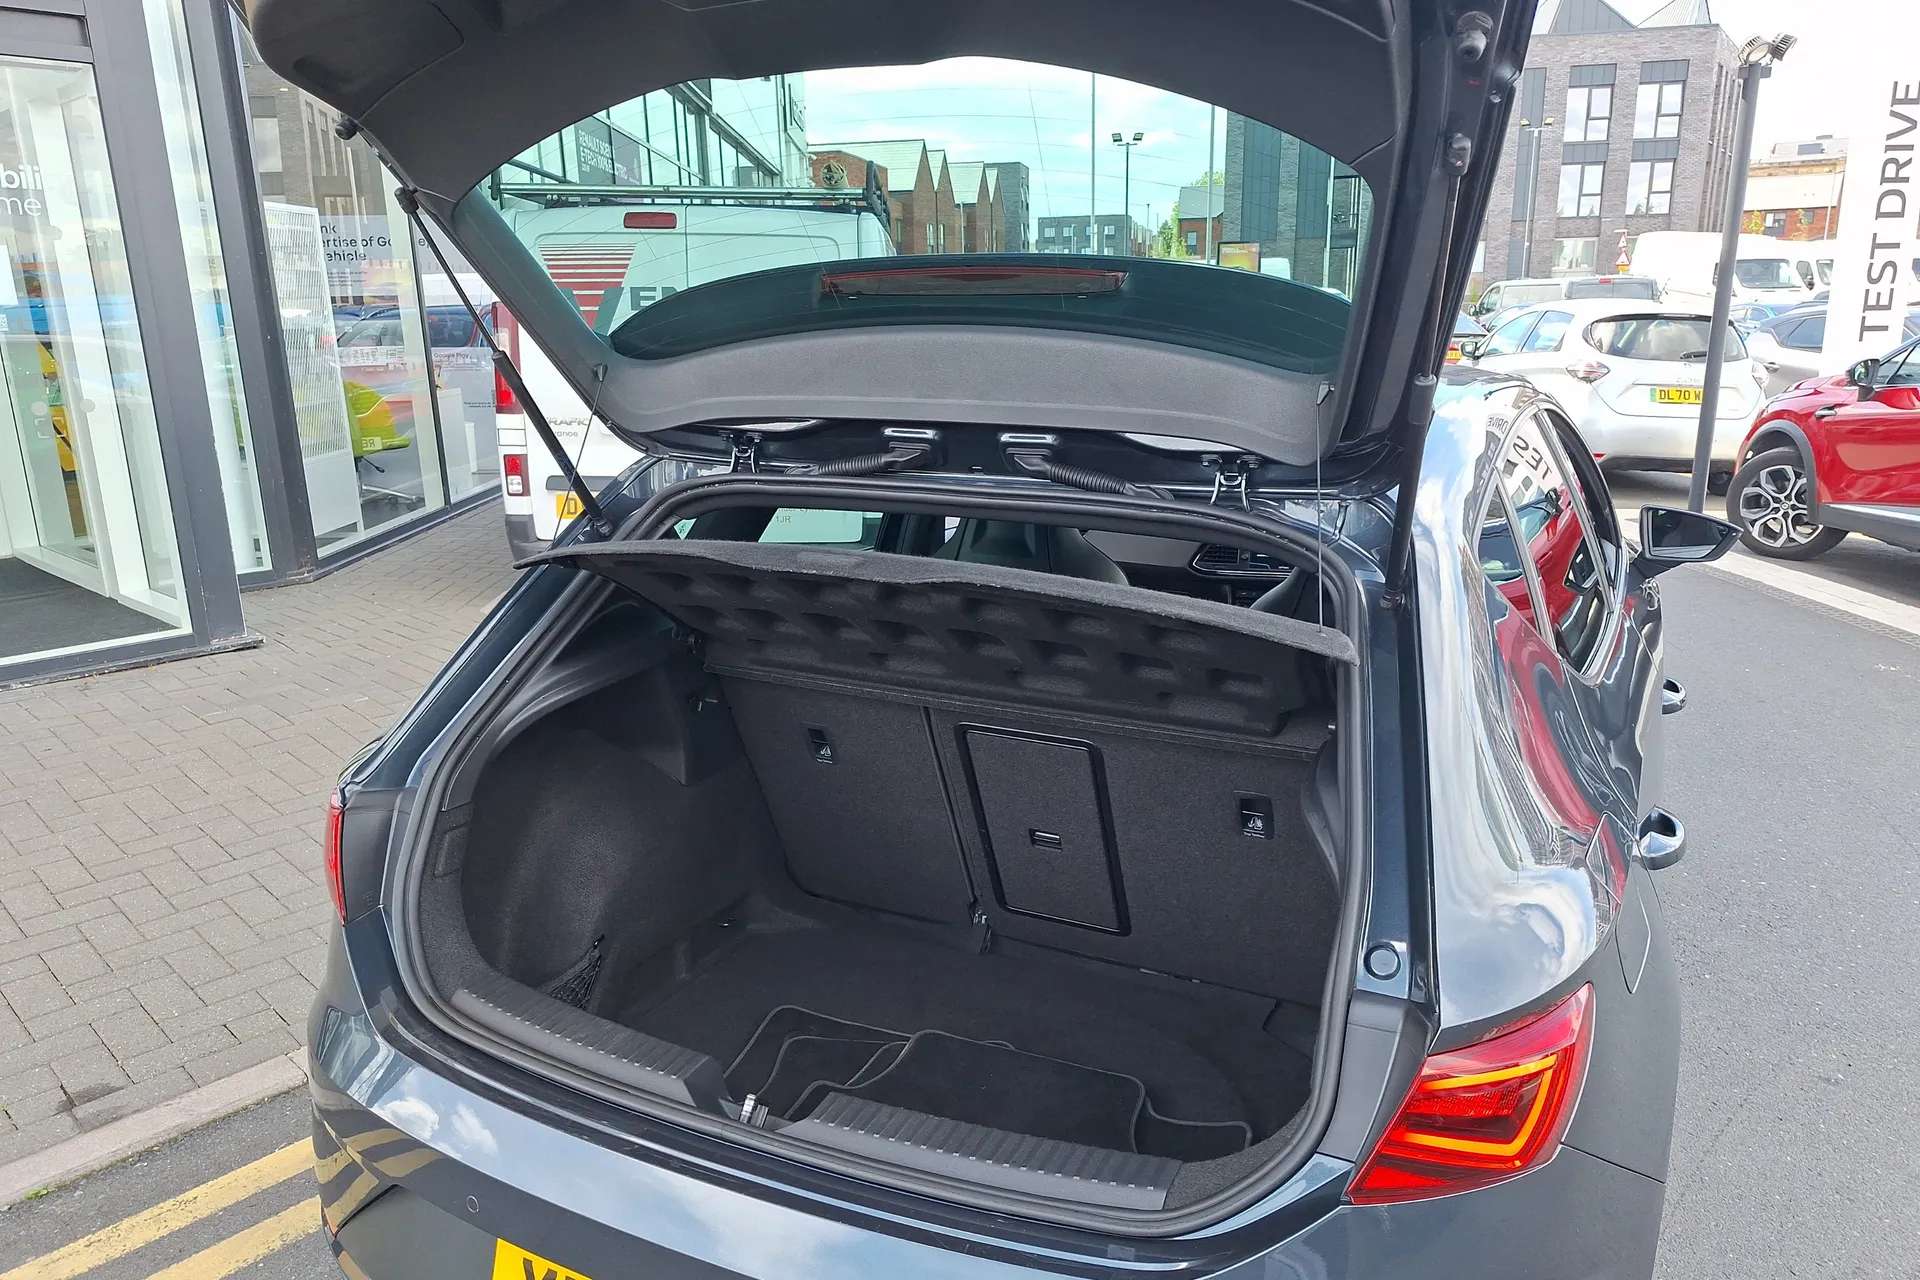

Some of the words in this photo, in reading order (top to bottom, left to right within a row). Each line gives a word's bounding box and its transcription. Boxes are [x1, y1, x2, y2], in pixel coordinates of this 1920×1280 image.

[1875, 81, 1920, 220] DRIVE
[0, 163, 43, 189] bili
[361, 236, 374, 247] of
[326, 250, 366, 261] ehicle
[1859, 233, 1900, 342] TEST
